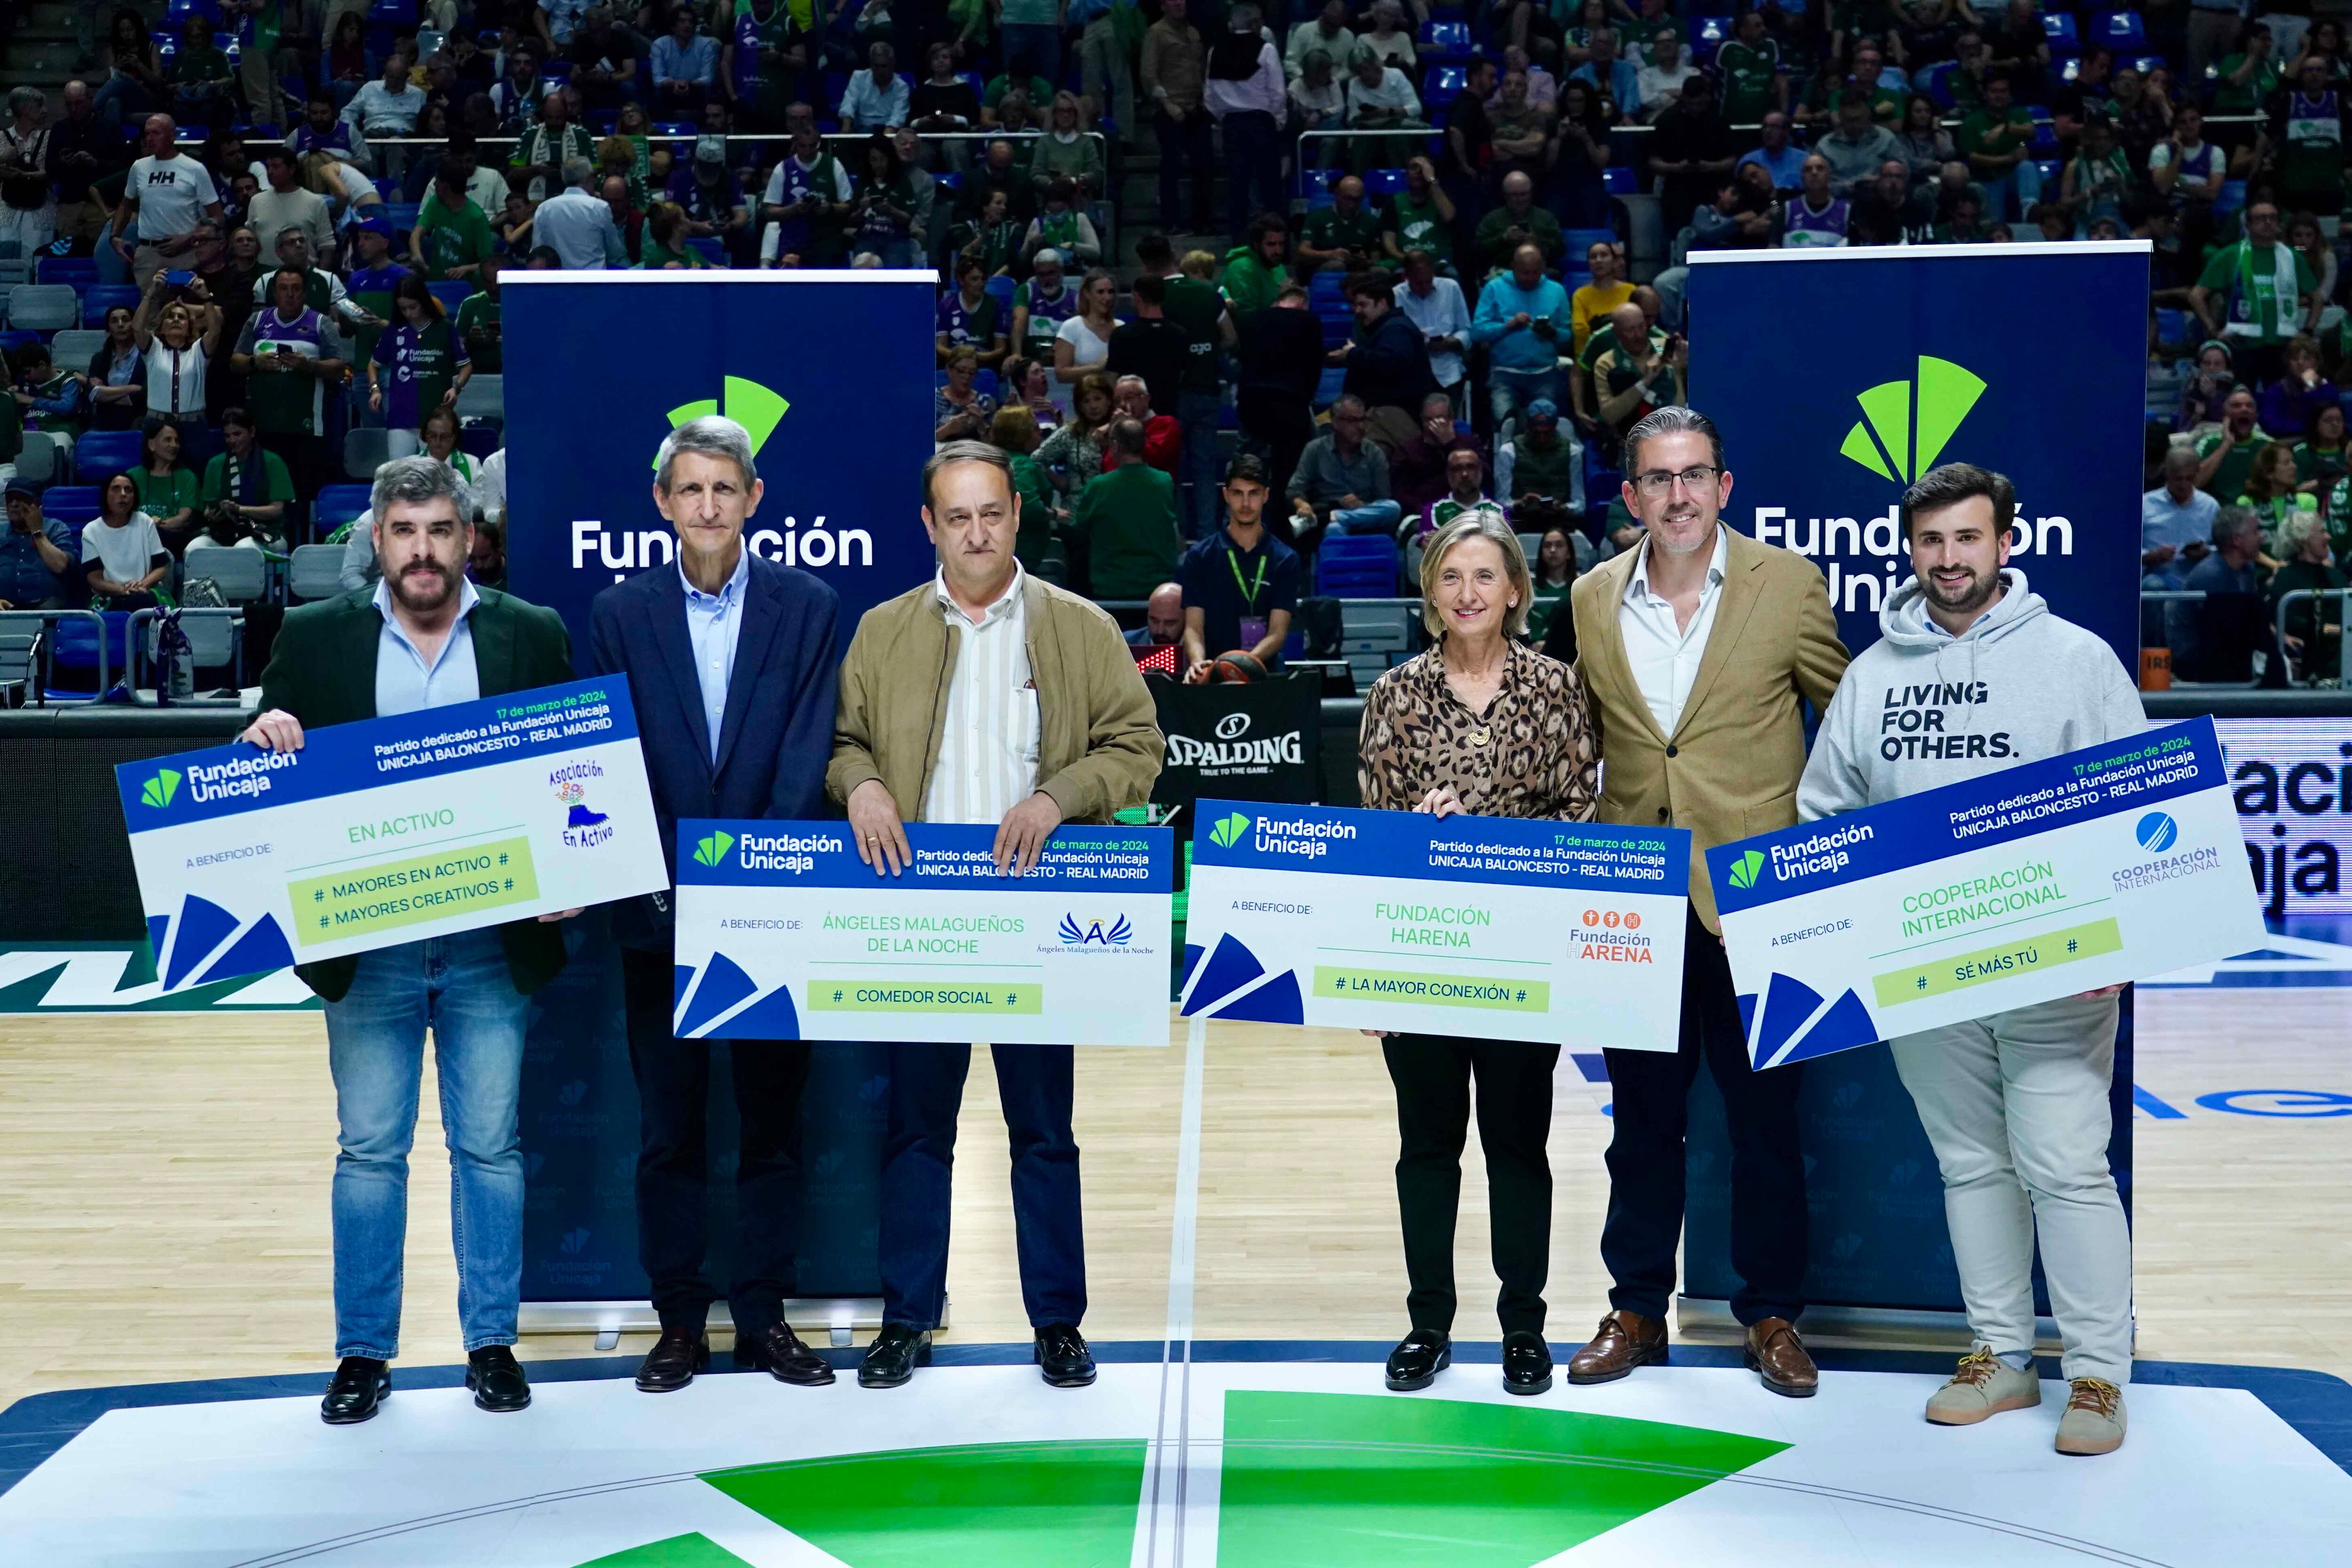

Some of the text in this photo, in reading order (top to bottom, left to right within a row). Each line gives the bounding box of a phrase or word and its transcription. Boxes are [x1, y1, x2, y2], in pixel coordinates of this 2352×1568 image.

[572, 516, 873, 568] Función
[1755, 503, 2072, 556] Fundón
[497, 691, 606, 718] 17 de marzo de 2024
[1884, 681, 1988, 709] LIVING
[374, 704, 610, 756] Partido dedicado a la Fundación Unicaja
[1881, 709, 1945, 734] FOR
[377, 751, 434, 772] UNICAJA
[435, 735, 520, 761] BALONCESTO
[530, 727, 563, 742] REAL
[564, 717, 612, 736] MADRID
[1167, 731, 1303, 766] SPALDING
[1880, 732, 2019, 761] OTHERS.
[2073, 736, 2191, 776] 17 de marzo de 2024
[187, 750, 297, 784] Fundación
[550, 759, 604, 787] Asociación
[191, 773, 271, 802] Unicaja
[1949, 751, 2195, 824] Partido dedicado a la Fundación Unicaja
[1953, 815, 2010, 839] UNICAJA
[2011, 791, 2099, 824] BALONCESTO
[2109, 780, 2145, 798] REAL
[2145, 765, 2198, 788] MADRID
[348, 809, 454, 844] EN ACTIVO
[563, 825, 613, 848] En Activo
[1256, 816, 1356, 839] Fundación
[187, 844, 274, 868] A BENEFICIO DE:
[741, 834, 842, 854] Fundación
[1046, 840, 1149, 851] de marzo de 2024
[1255, 834, 1327, 860] Unicaja
[1430, 840, 1665, 868] Partido dedicado a la Fundación Unicaja
[1554, 835, 1666, 851] 17 de marzo de 2024
[1770, 824, 1874, 867] Fundación
[740, 852, 813, 875] Unicaja
[916, 864, 970, 876] UNICAJA
[1067, 867, 1098, 878] REAL
[1100, 868, 1149, 879] MADRID
[917, 850, 960, 861] Partido
[1042, 852, 1103, 863] Fundación
[1105, 853, 1149, 867] Unicaja
[1429, 854, 1482, 868] UNICAJA
[1485, 858, 1570, 874] BALONCESTO
[1581, 864, 1612, 877] REAL
[1614, 867, 1664, 880] MADRID
[1774, 850, 1849, 881] Unicaja
[2112, 846, 2217, 882] COOPERACIÓN
[314, 852, 509, 903] # MAYORES EN ACTIVO #
[1903, 860, 2053, 913] COOPERACIÓN
[2114, 858, 2221, 892] INTERNACIONAL
[319, 877, 514, 928] # MAYORES CREATIVOS #
[1232, 901, 1313, 915] A BENEFICIO DE:
[1375, 903, 1490, 926] FUNDACIÓN
[1902, 883, 2066, 938] INTERNACIONAL
[721, 919, 803, 930] A BENEFICIO DE:
[823, 911, 1024, 932] ÁNGELES MALAGUEÑOS
[1772, 919, 1853, 947] A BENEFICIO DE:
[868, 938, 979, 953] DE LA NOCHE
[1037, 944, 1065, 954] Ángeles
[1067, 946, 1110, 955] Malagueños
[1392, 927, 1470, 947] HARENA
[1570, 929, 1650, 947] Fundación
[1567, 942, 1653, 964] HARENA
[1917, 939, 2078, 990] # SÉ MÁS TÚ #
[833, 989, 1017, 1005] # COMEDOR SOCIAL #
[1335, 977, 1527, 1003] # LA MAYOR CONEXIÓN #
